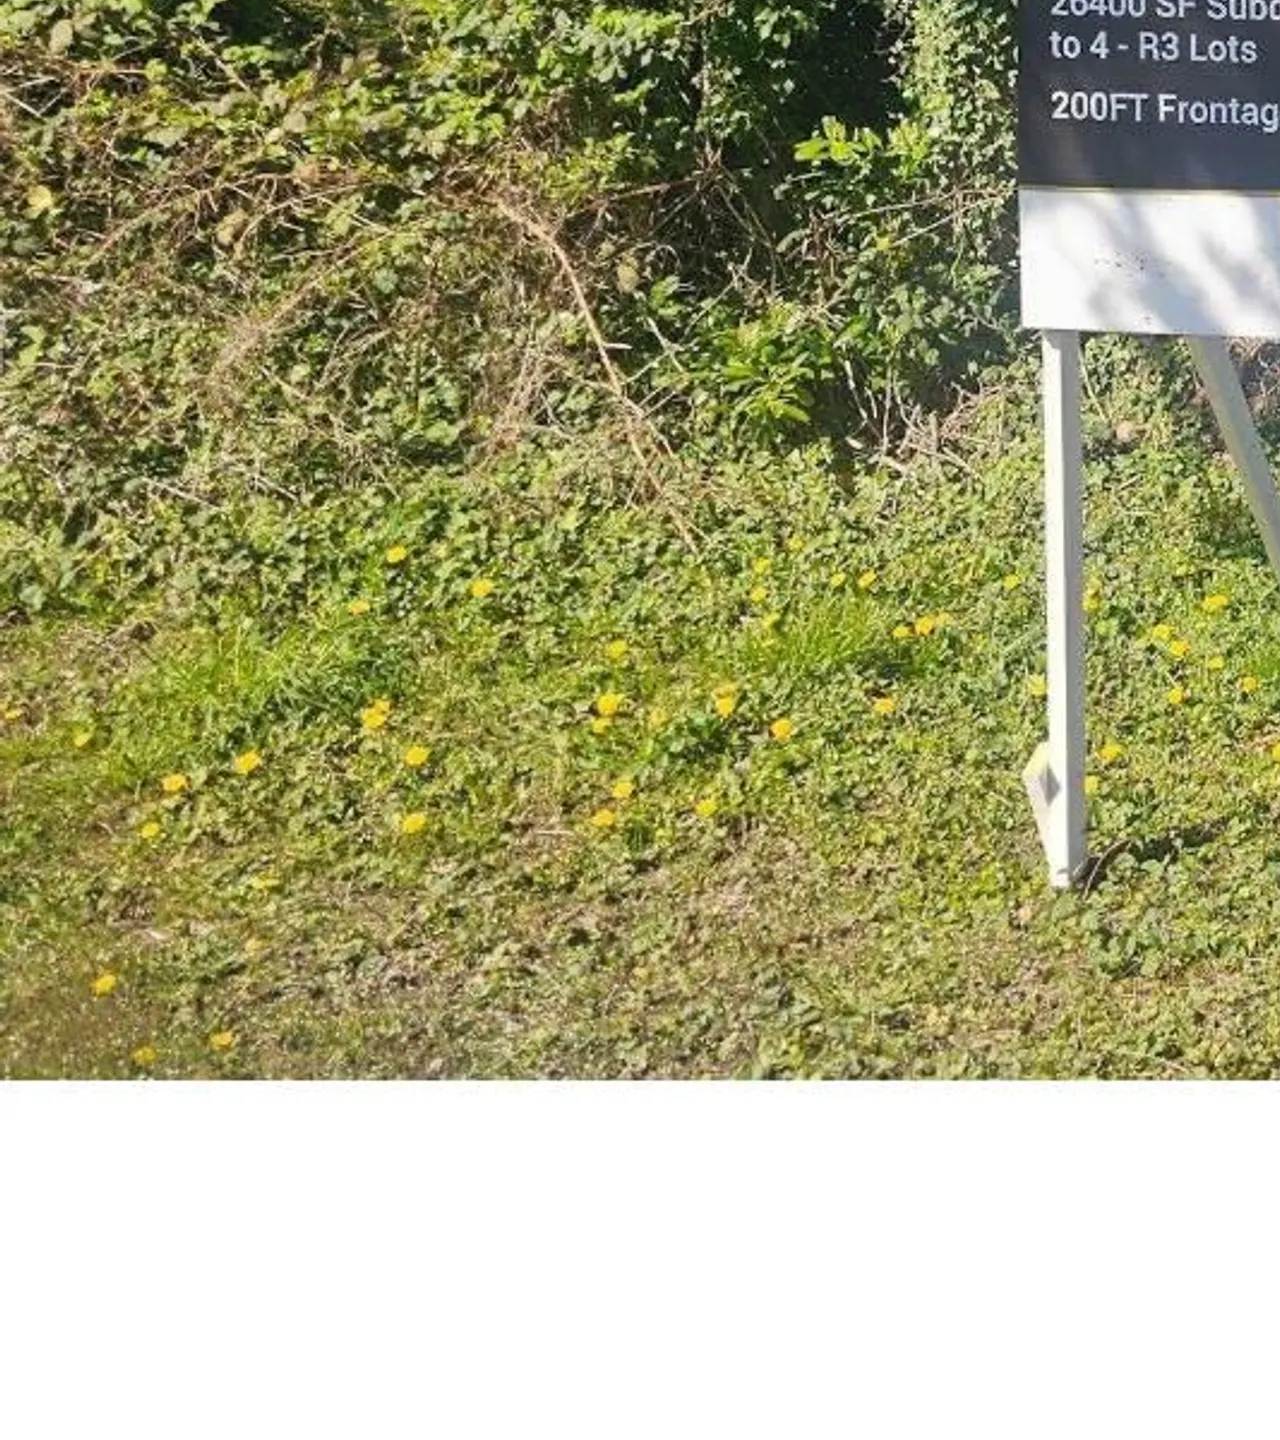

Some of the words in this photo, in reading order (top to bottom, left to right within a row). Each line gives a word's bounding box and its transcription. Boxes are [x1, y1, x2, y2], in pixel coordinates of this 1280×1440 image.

[1048, 30, 1082, 59] to
[1089, 30, 1110, 60] 4
[1117, 43, 1129, 51] -
[1139, 30, 1180, 62] R3
[1189, 32, 1259, 64] Lots
[1050, 89, 1150, 123] 200FT
